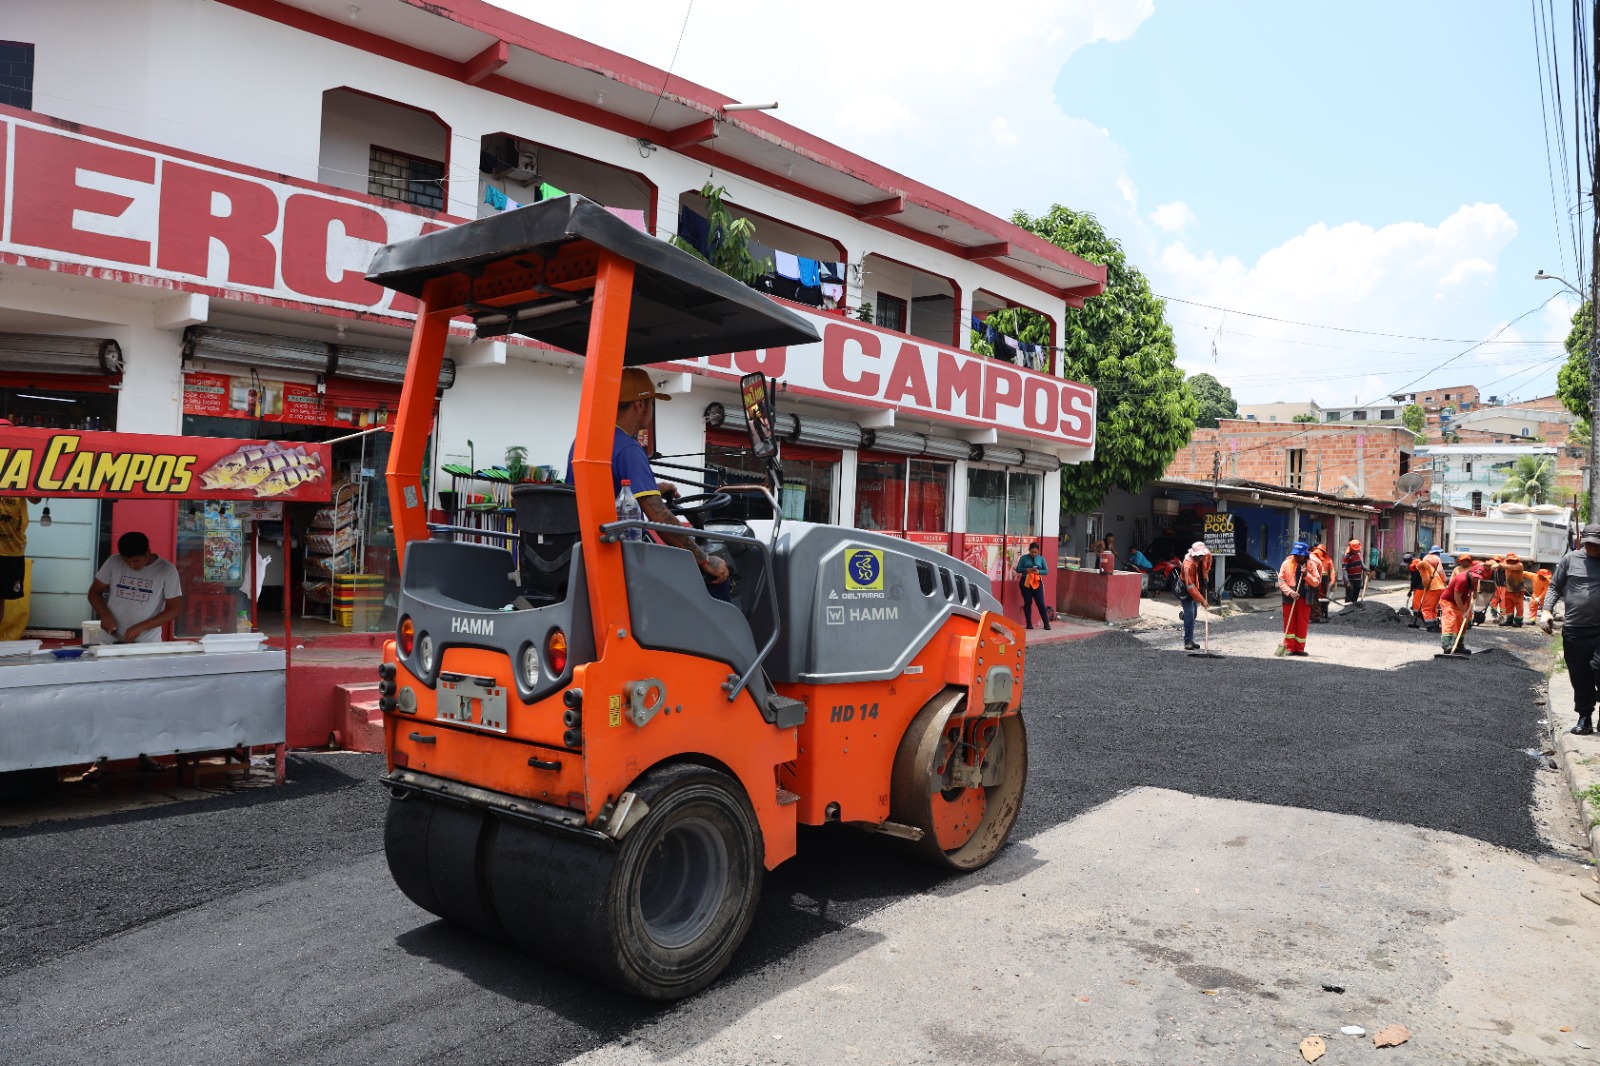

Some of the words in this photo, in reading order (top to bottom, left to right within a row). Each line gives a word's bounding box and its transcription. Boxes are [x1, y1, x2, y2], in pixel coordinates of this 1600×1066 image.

[823, 322, 1092, 439] CAMPOS
[37, 435, 198, 493] CAMPOS
[1204, 522, 1234, 533] POÇO
[1205, 514, 1228, 523] DISK
[849, 607, 899, 621] HAMM
[451, 616, 495, 637] HAMM
[830, 704, 855, 723] HD
[860, 703, 880, 720] 14
